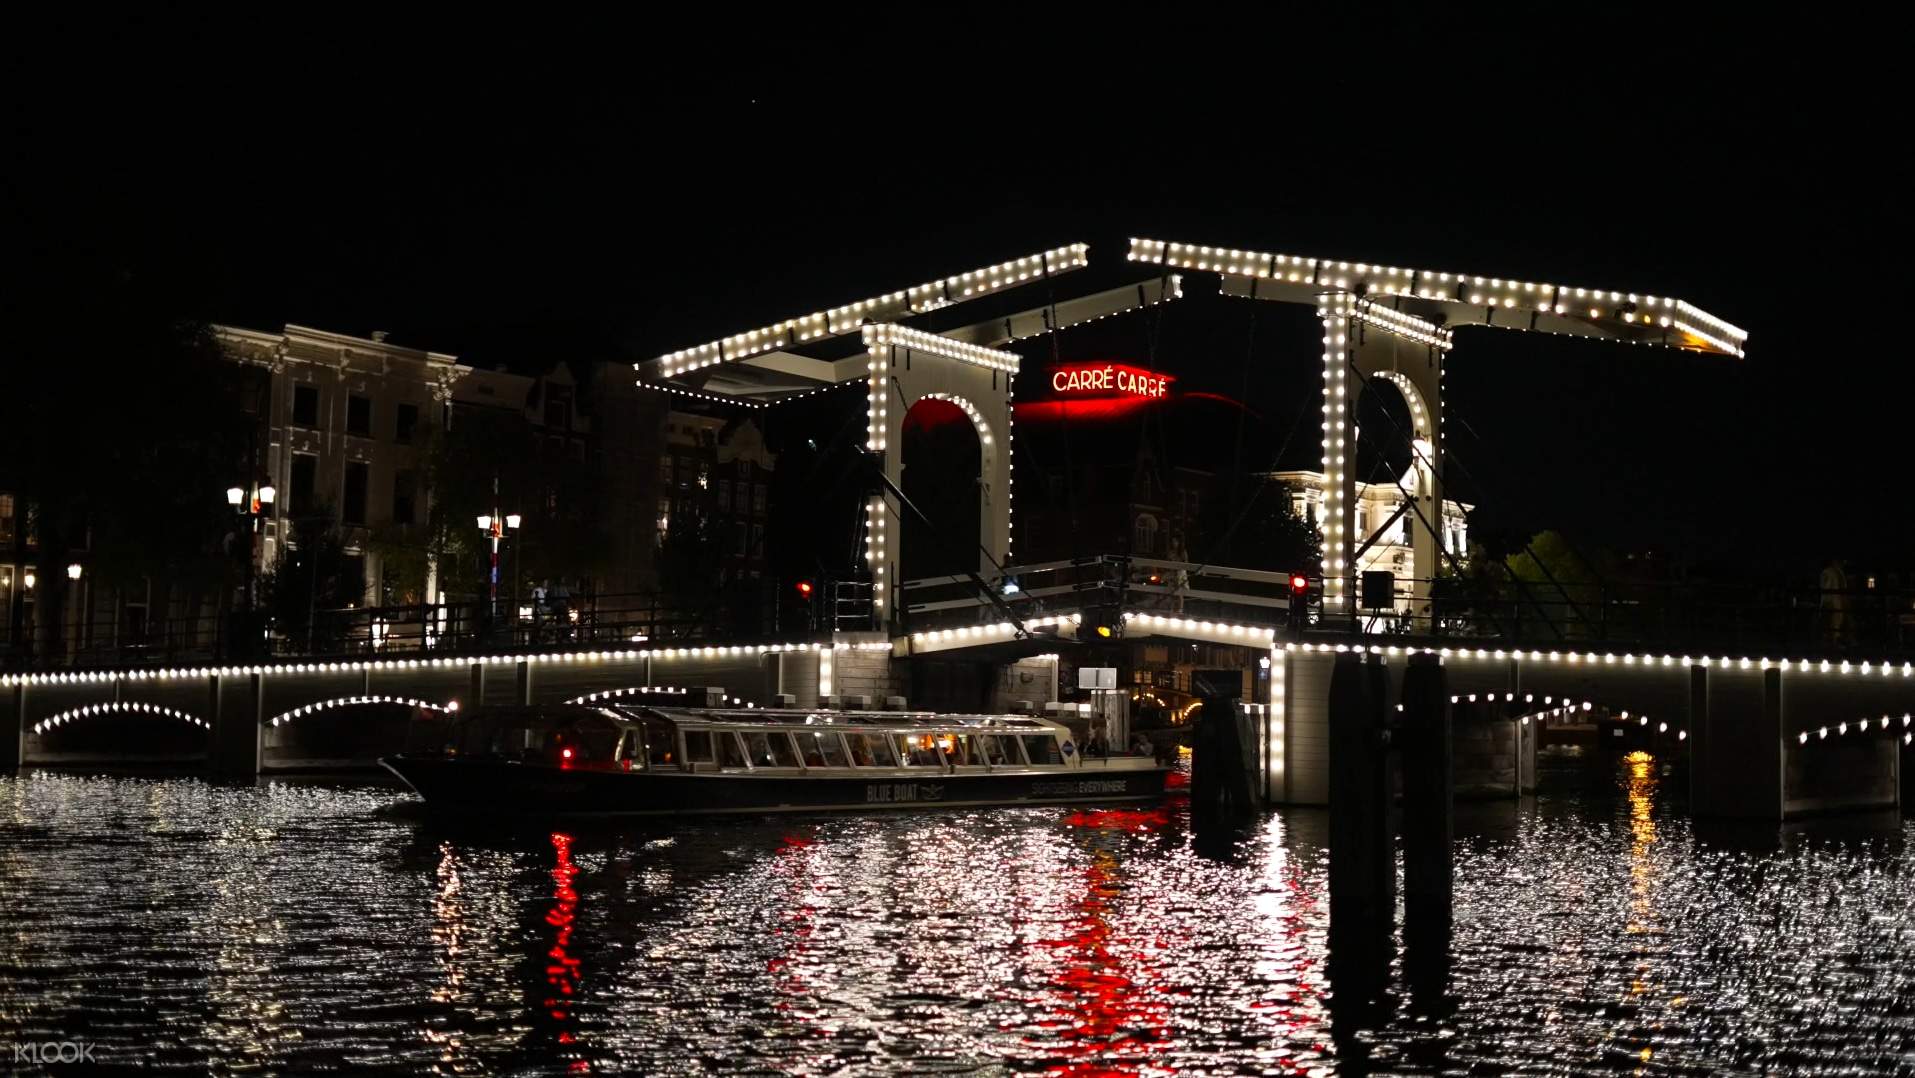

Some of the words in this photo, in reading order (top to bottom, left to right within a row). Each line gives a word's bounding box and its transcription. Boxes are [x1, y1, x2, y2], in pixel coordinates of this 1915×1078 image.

[1052, 364, 1113, 391] CARRÉ
[867, 783, 892, 801] BLUE
[894, 783, 917, 801] BOAT
